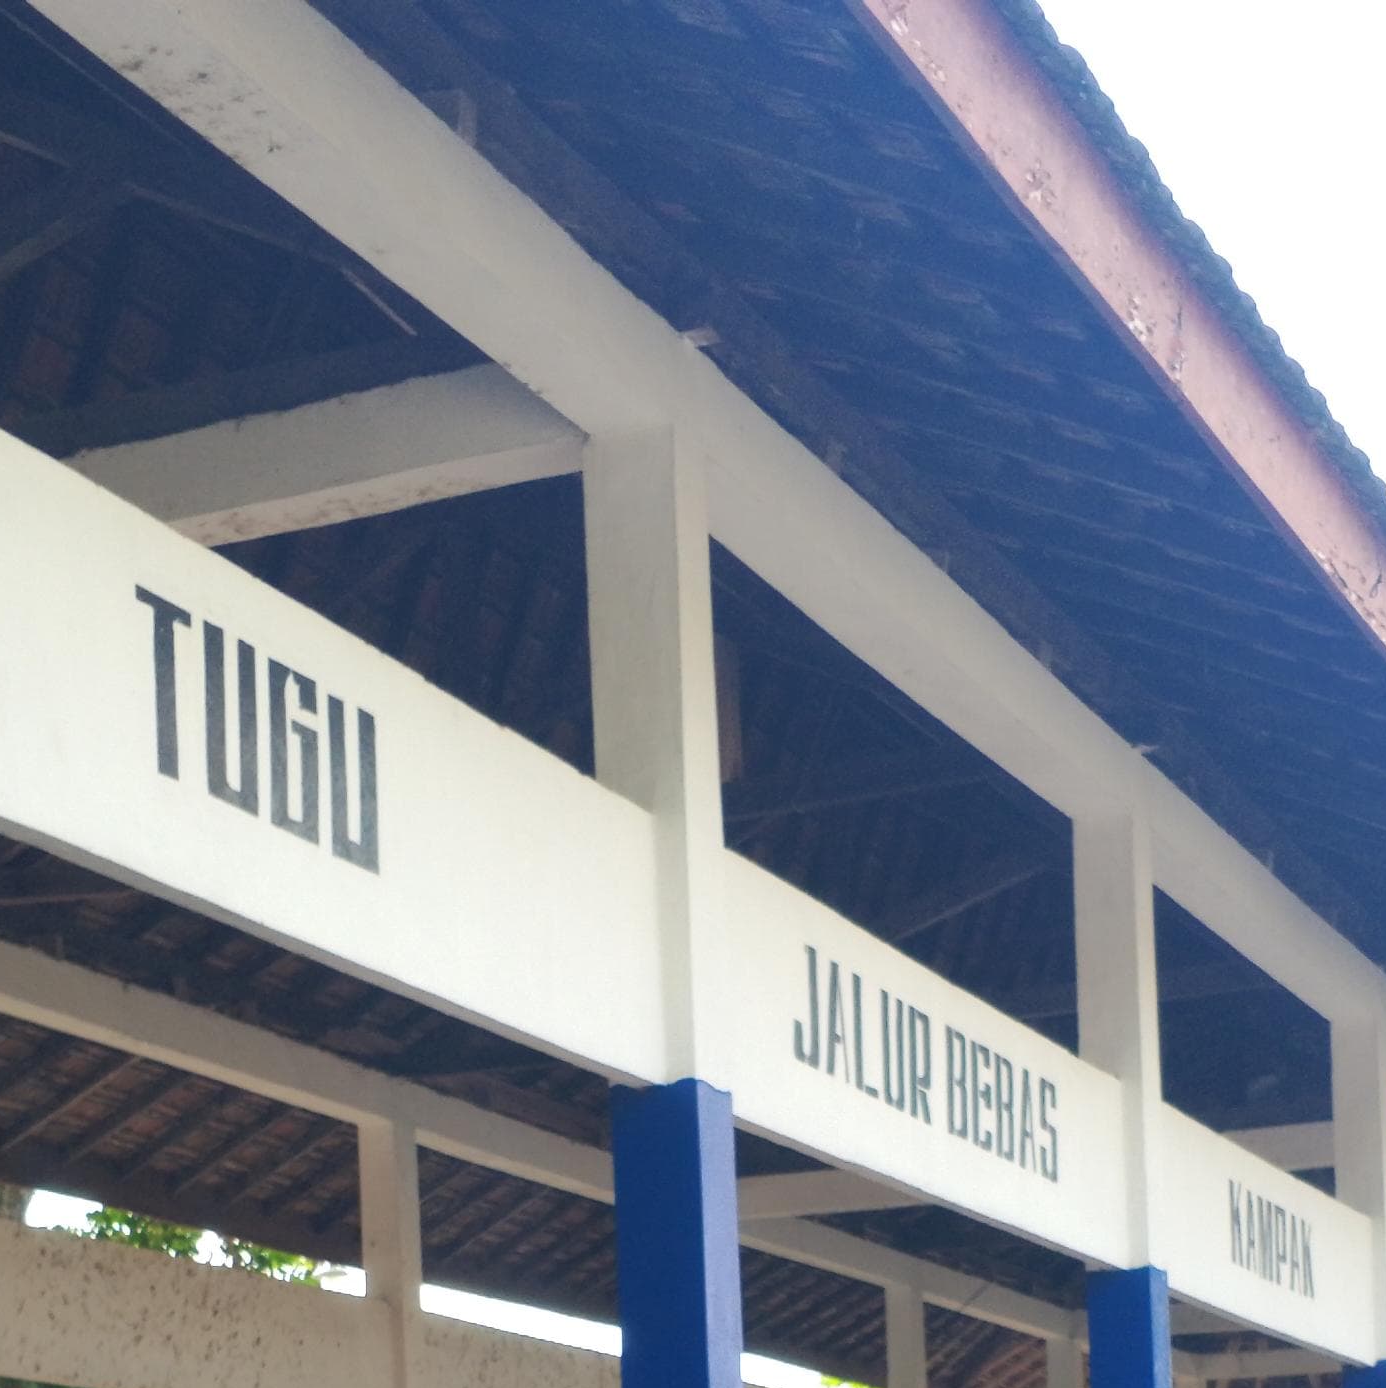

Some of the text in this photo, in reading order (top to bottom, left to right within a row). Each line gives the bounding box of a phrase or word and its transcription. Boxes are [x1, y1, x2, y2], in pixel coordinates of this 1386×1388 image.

[135, 584, 380, 876] TUGU
[793, 944, 1058, 1182] JALUR BEBAS
[1229, 1178, 1315, 1299] KAMPAK
